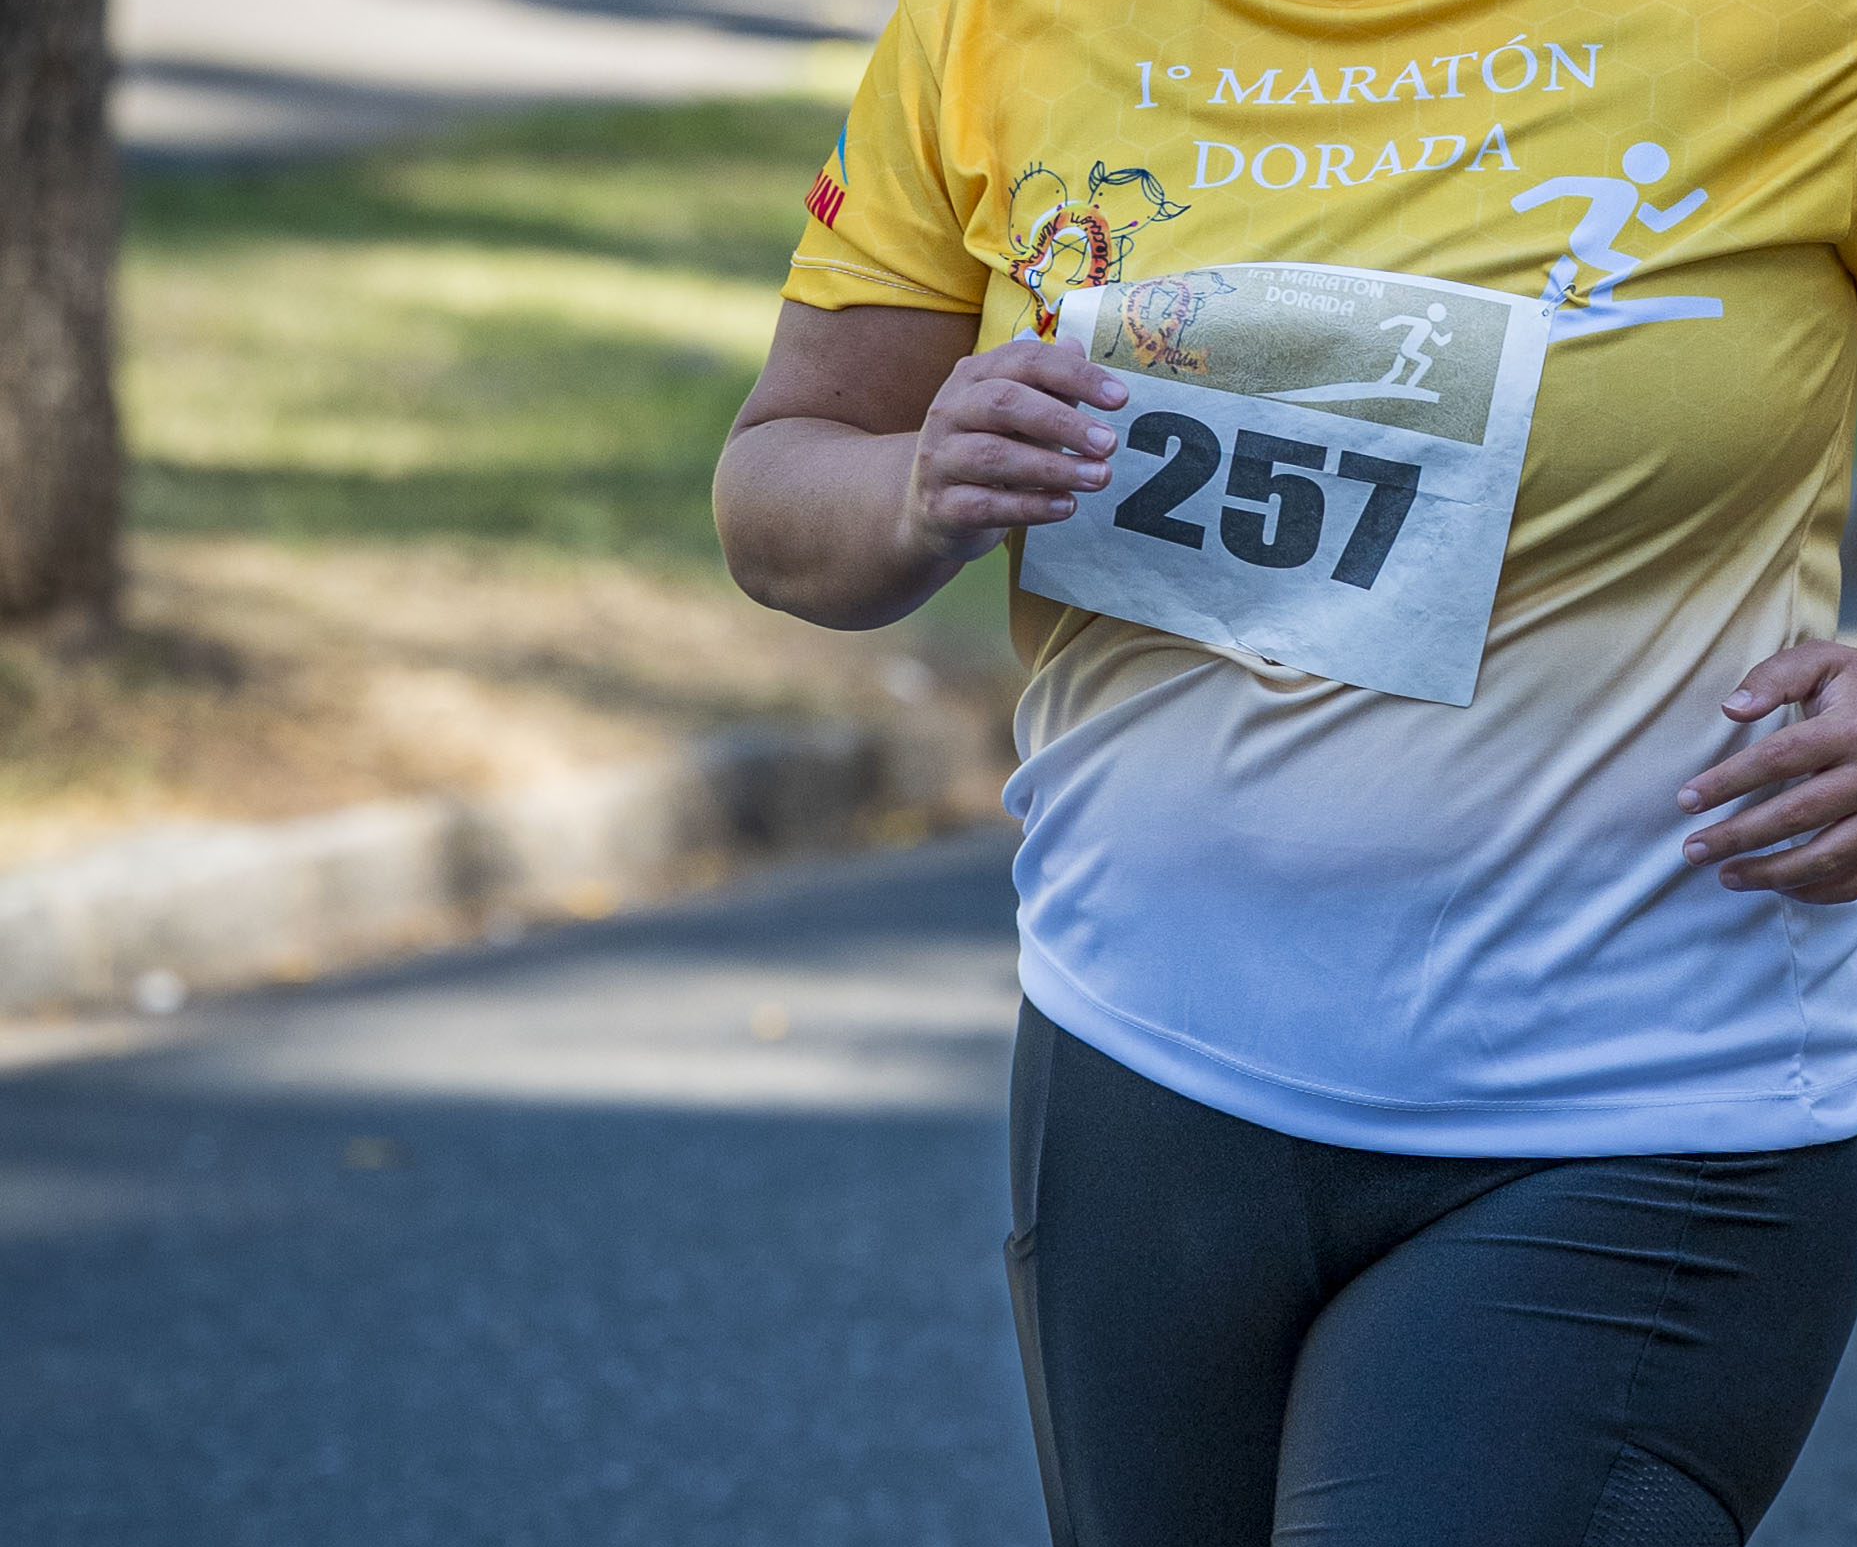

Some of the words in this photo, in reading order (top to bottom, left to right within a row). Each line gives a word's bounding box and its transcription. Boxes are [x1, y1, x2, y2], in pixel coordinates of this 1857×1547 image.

[1207, 33, 1603, 106] MARATÓN
[1188, 122, 1521, 190] DORADA
[1264, 285, 1356, 317] DORADA
[1113, 409, 1423, 591] 257
